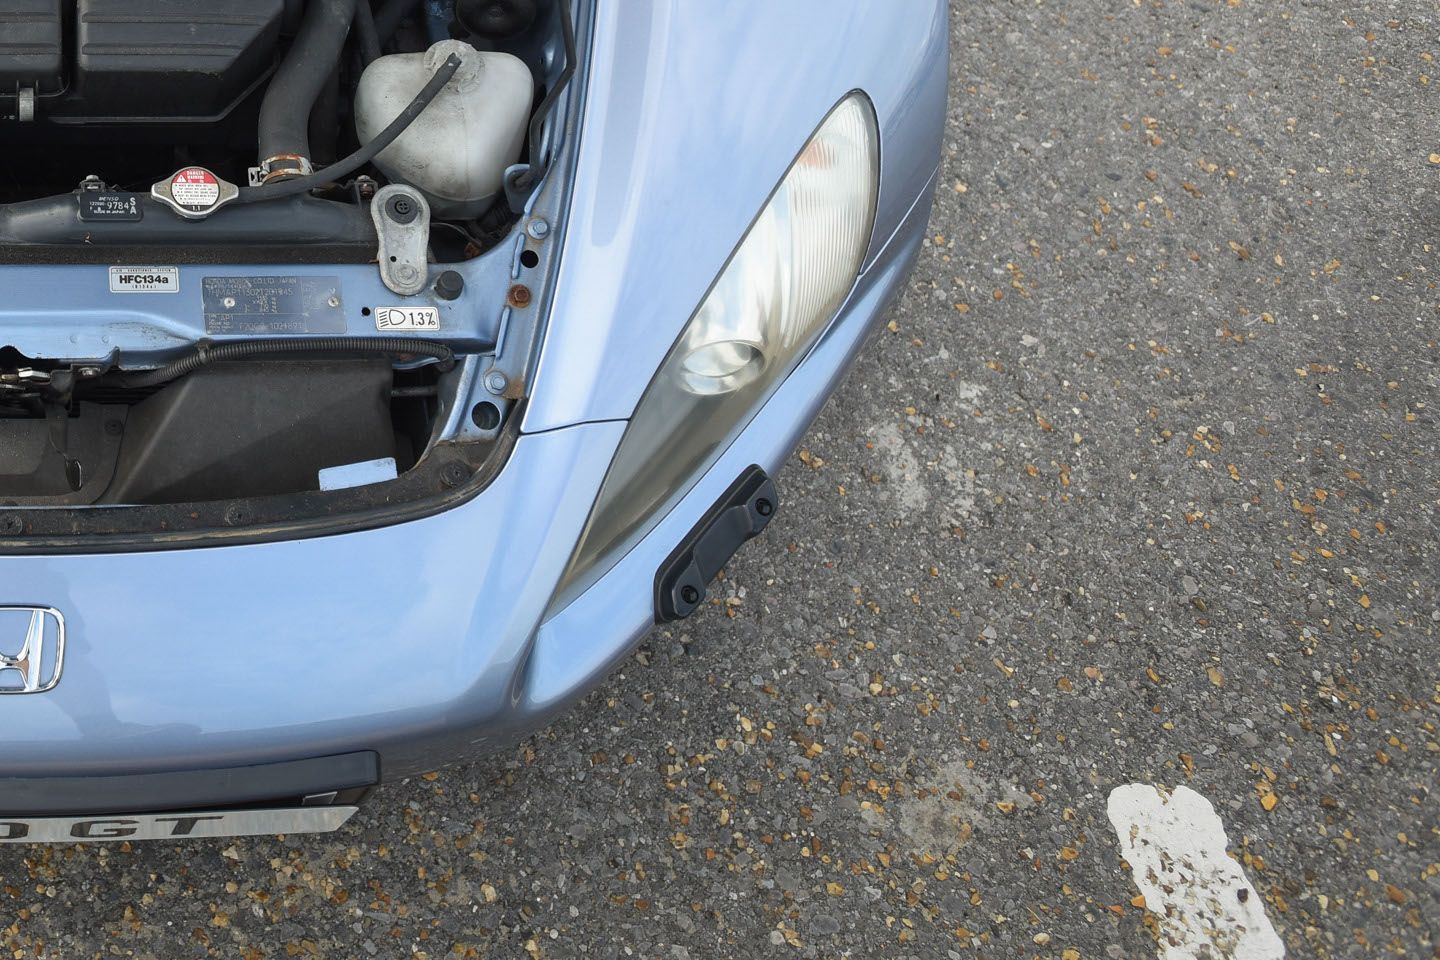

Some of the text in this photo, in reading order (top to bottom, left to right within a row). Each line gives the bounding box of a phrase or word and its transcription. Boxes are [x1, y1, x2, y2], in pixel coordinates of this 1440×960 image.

[106, 201, 130, 210] 9784
[129, 205, 137, 215] A
[119, 274, 169, 284] HFC134a
[409, 312, 436, 326] 1.3%
[69, 815, 224, 839] GT
